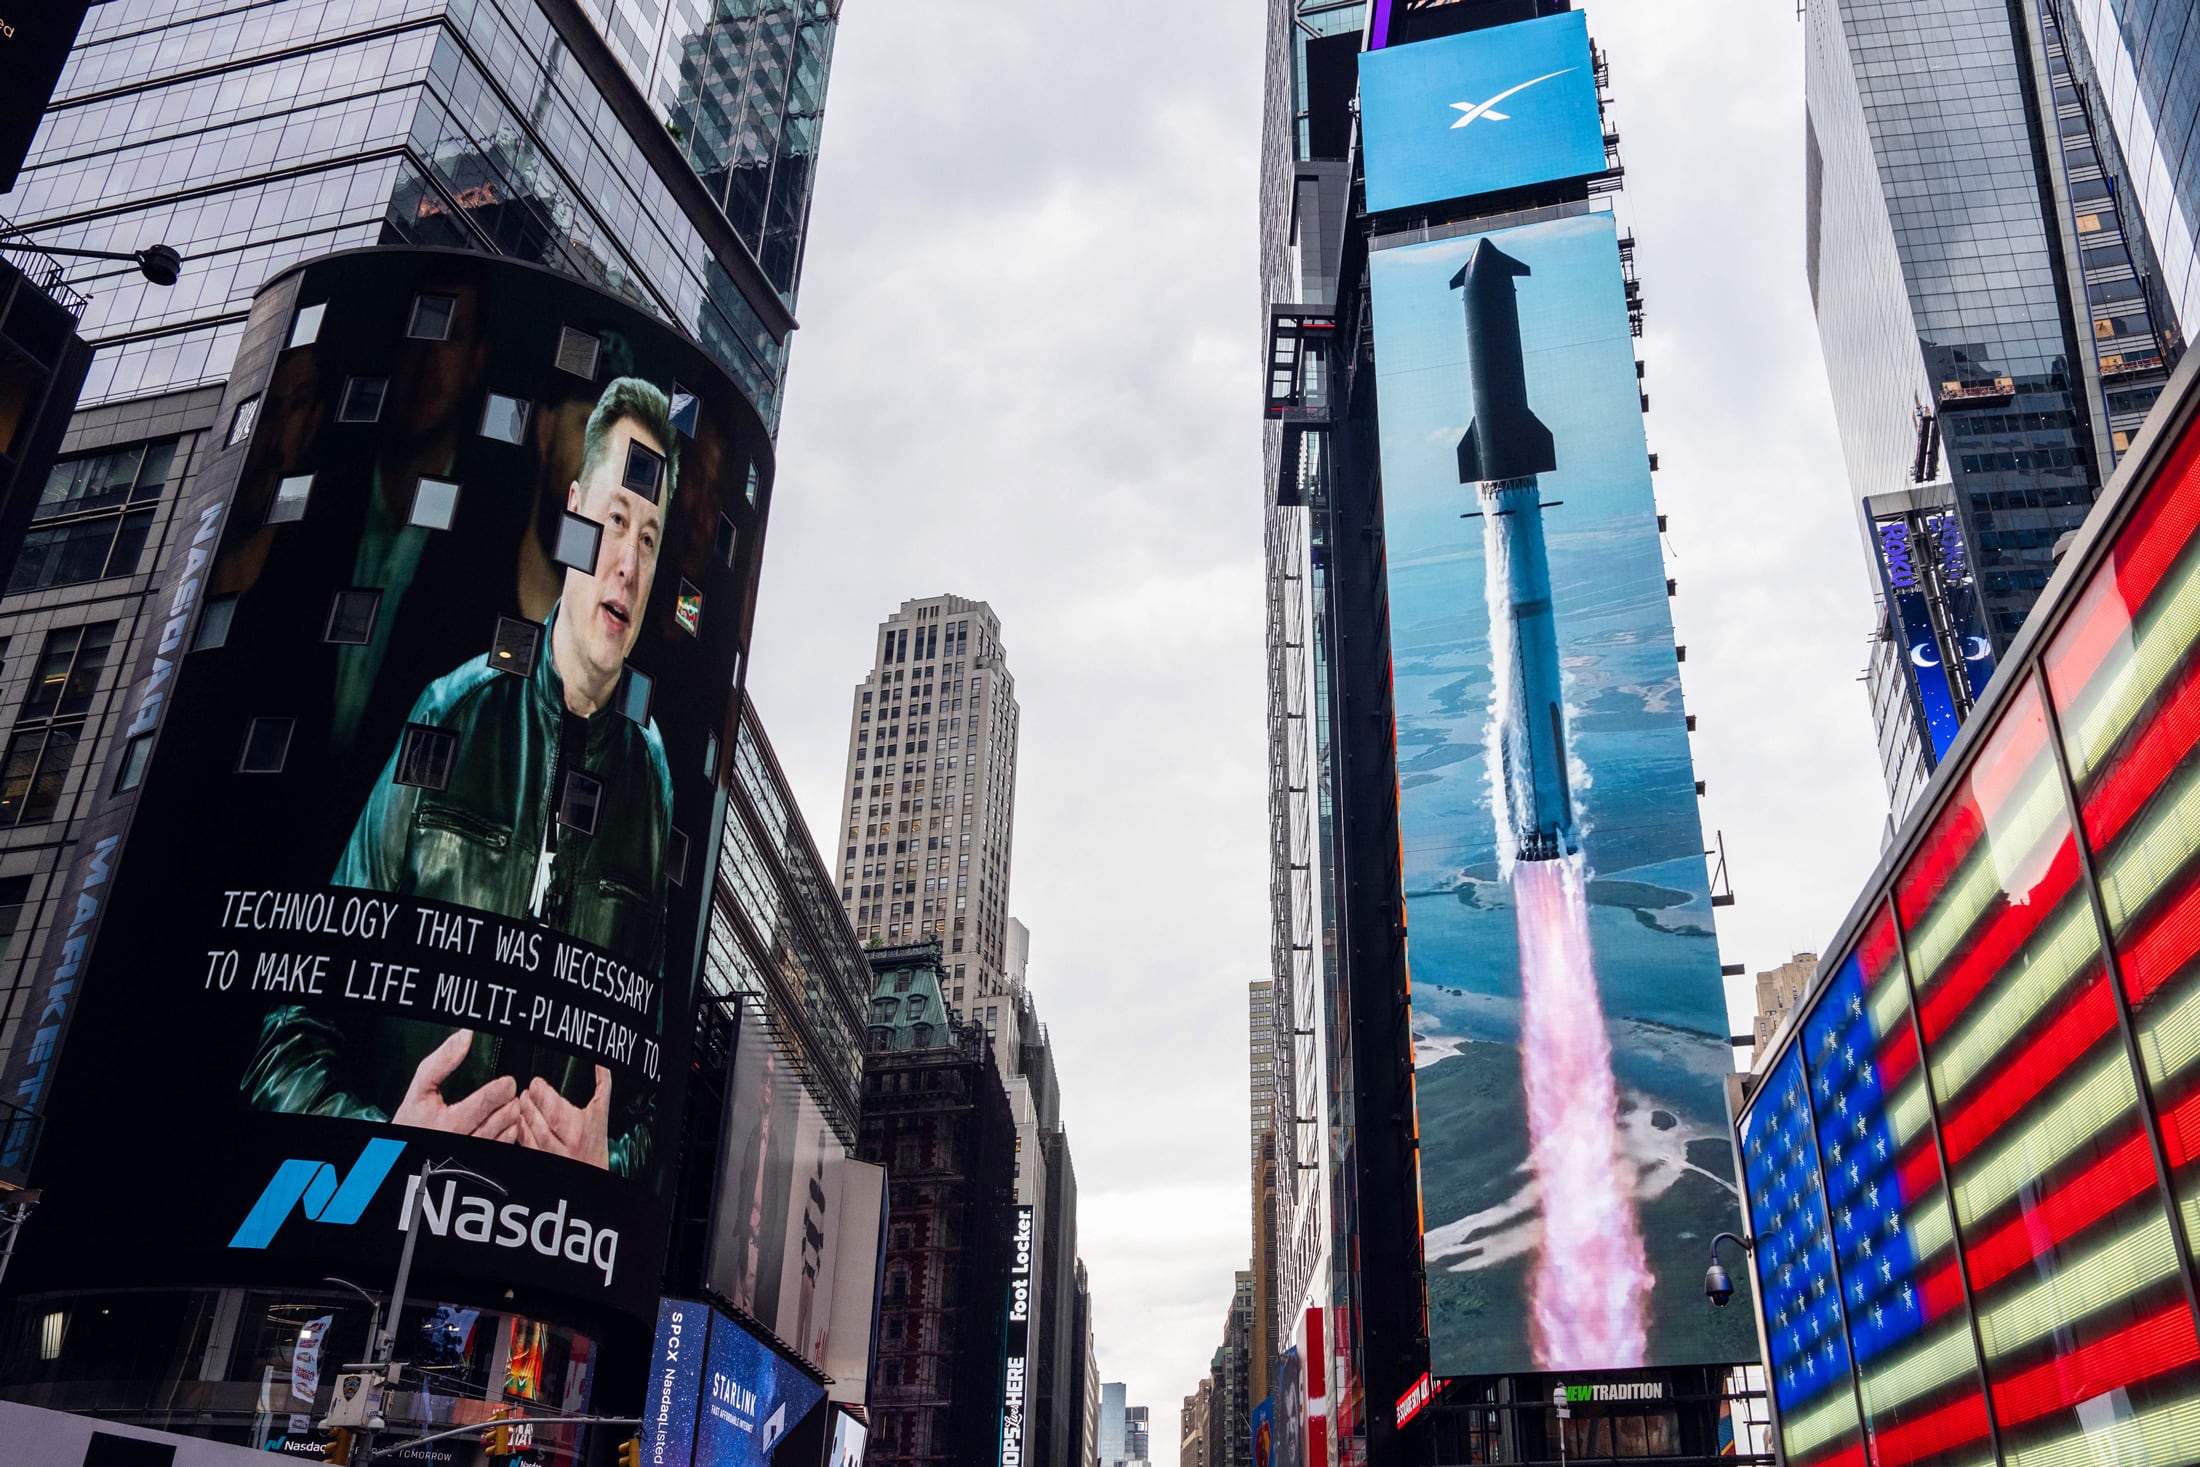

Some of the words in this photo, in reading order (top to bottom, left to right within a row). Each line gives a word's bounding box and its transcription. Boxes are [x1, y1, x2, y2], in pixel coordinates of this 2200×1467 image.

[1880, 523, 1915, 588] ROKU
[126, 502, 225, 739] NASDAQ
[221, 890, 399, 939] TECHNOLOGY
[416, 907, 484, 955] THAT
[496, 925, 542, 972] WAS
[553, 942, 655, 1015] NECESSARY
[205, 950, 239, 991] TO
[252, 952, 330, 995] MAKE
[344, 959, 420, 1006] LIFE
[432, 974, 637, 1066] MULTI-PLANETARY
[644, 1038, 662, 1083] TO.
[398, 1174, 619, 1287] Nasdaq
[1010, 1279, 1029, 1321] Foot
[666, 1311, 683, 1362] SPCX
[713, 1371, 757, 1417] STARLINK
[1005, 1356, 1025, 1406] HERE
[284, 1439, 327, 1455] Nasdaq
[1002, 1427, 1021, 1467] OPS
